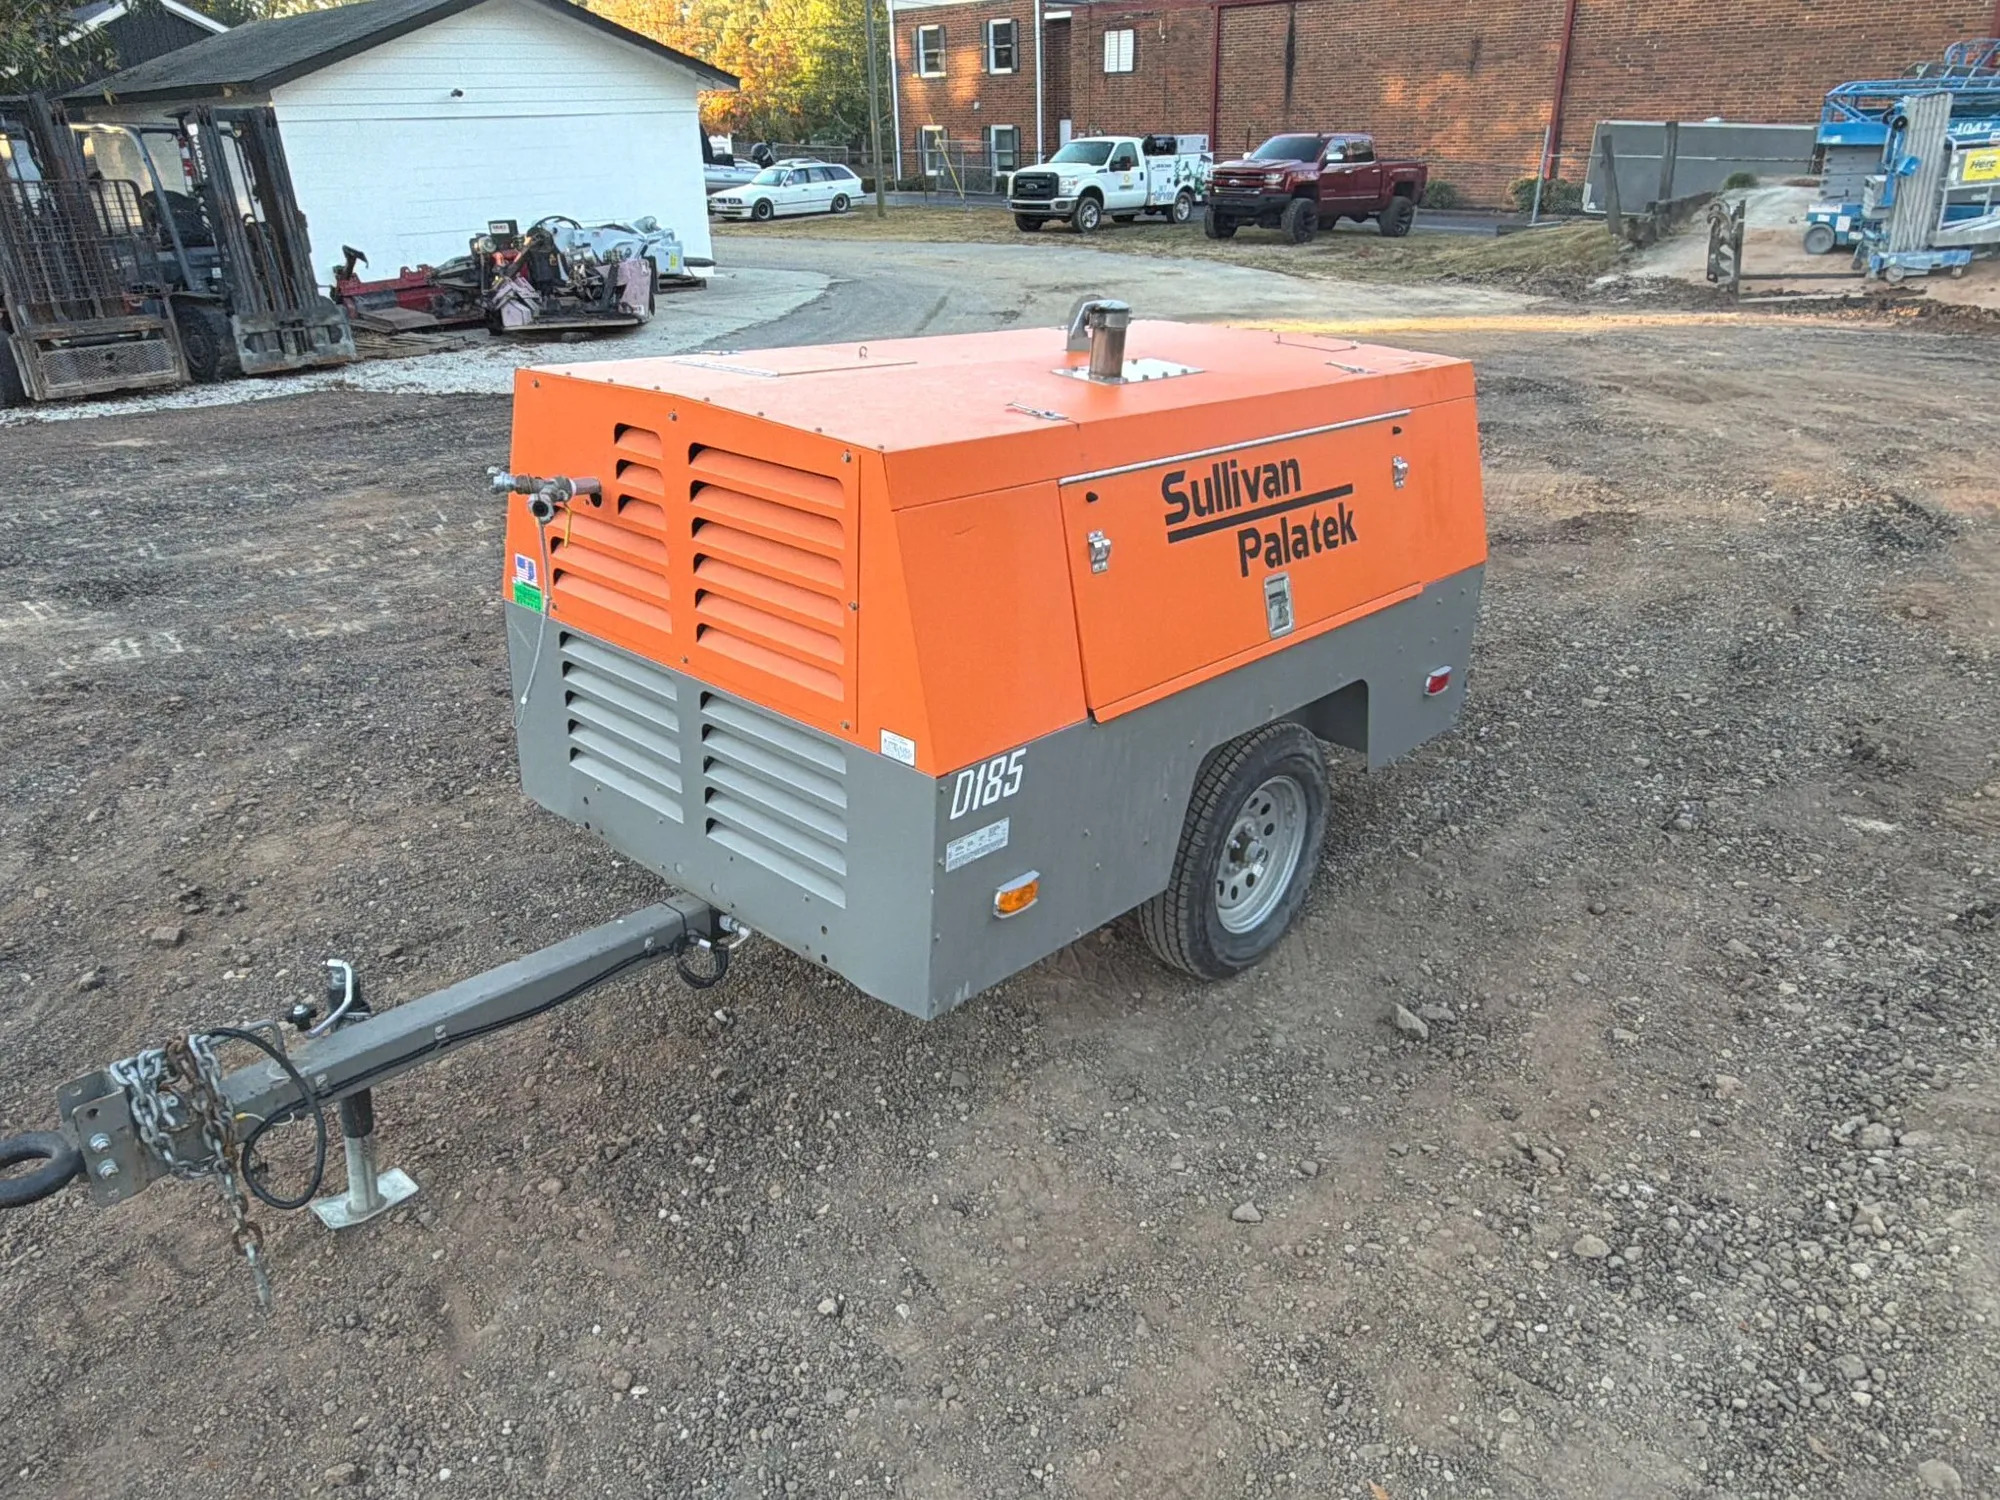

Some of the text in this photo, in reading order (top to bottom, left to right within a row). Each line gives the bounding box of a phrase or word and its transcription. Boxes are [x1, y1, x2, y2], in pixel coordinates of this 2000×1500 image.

[192, 135, 208, 179] TOYOTA
[1161, 458, 1302, 526] Sullivan
[1237, 502, 1358, 578] Palatek
[949, 747, 1027, 821] D185
